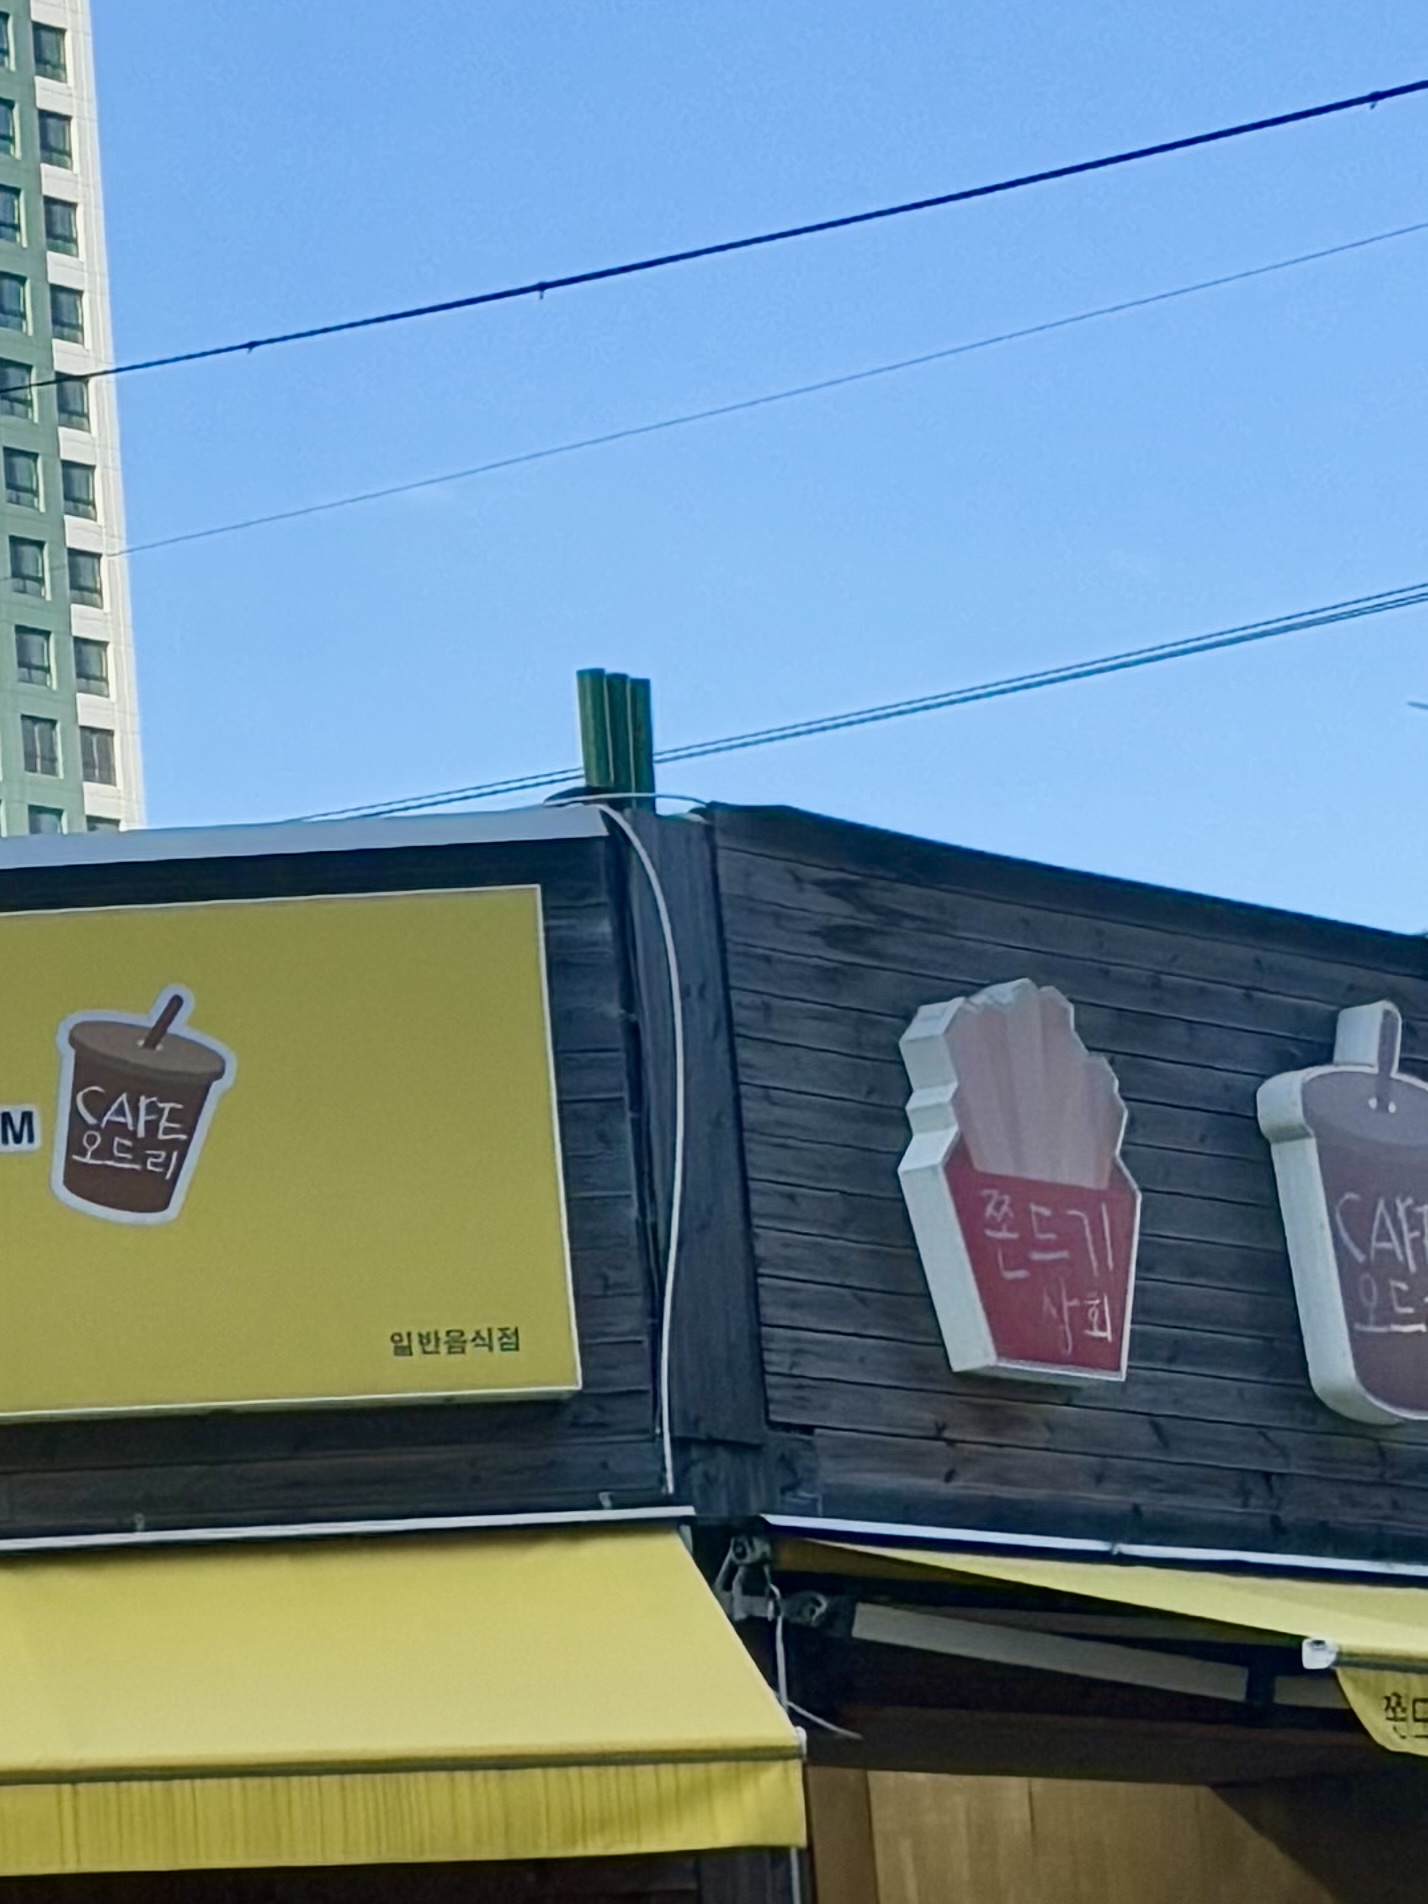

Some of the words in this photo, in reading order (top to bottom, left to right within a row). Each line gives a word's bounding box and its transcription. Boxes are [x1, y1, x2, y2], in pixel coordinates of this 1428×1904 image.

[75, 1085, 188, 1141] CAFE
[71, 1131, 180, 1180] 오드리
[981, 1188, 1115, 1280] 쫀드기
[1045, 1275, 1113, 1355] 상회
[1353, 1273, 1428, 1333] 오드
[389, 1326, 520, 1357] 일반음식점
